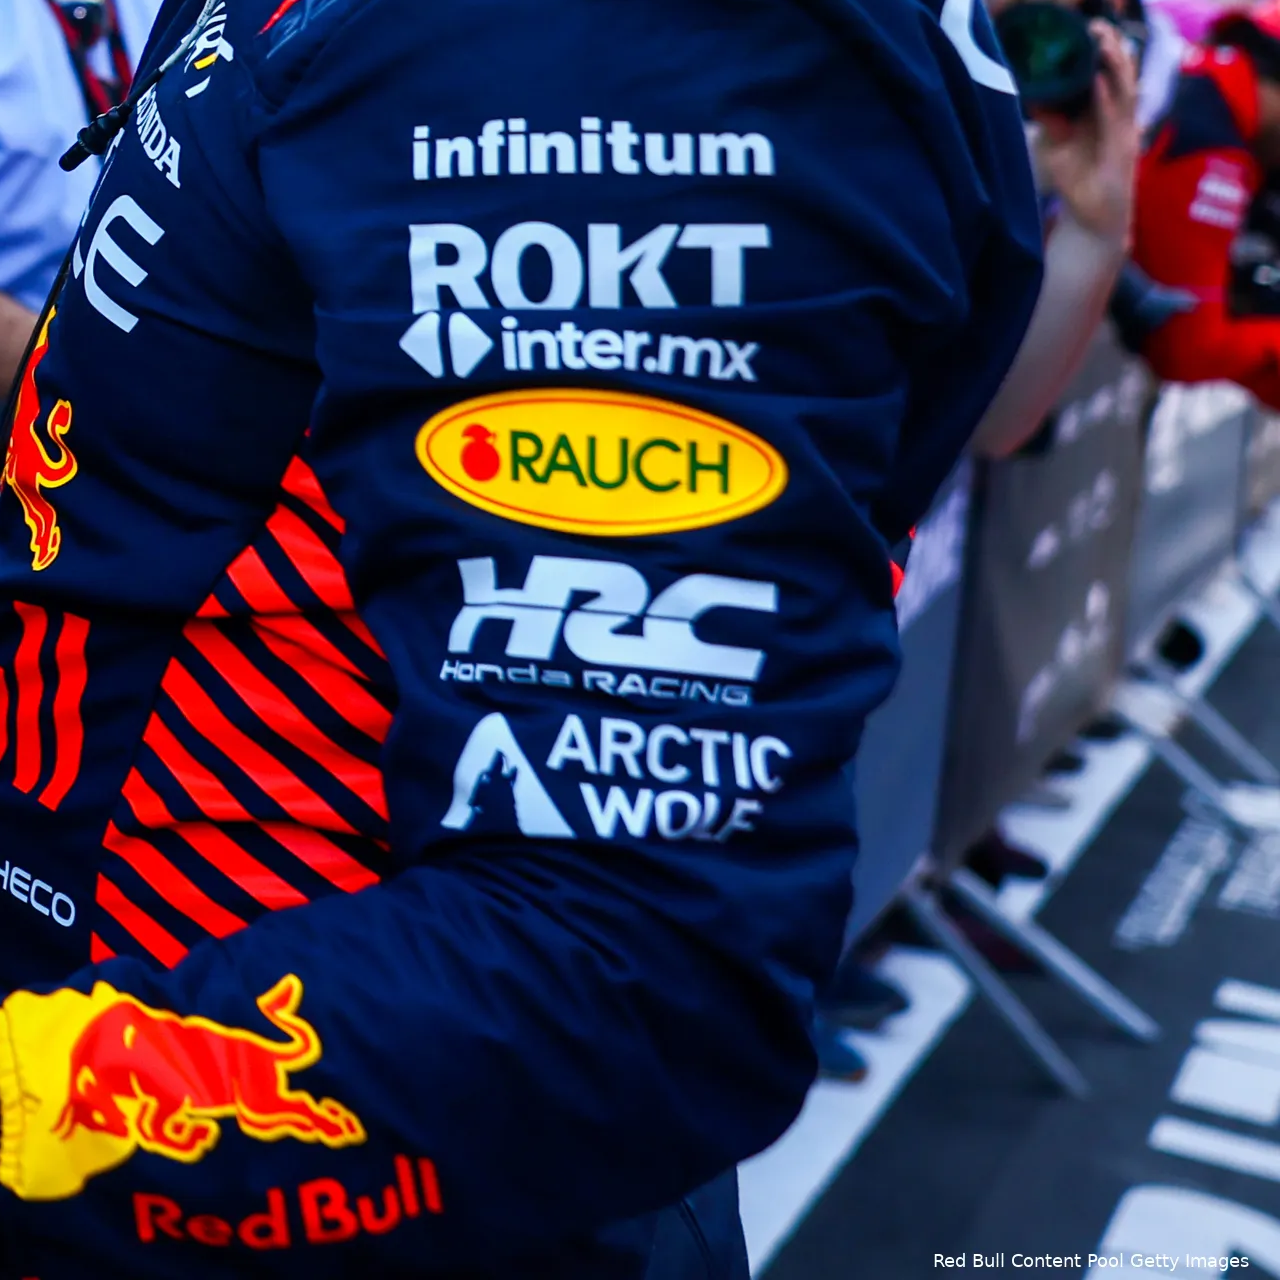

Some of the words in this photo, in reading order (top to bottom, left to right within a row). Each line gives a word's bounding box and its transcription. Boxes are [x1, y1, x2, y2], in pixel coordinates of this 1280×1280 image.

[412, 116, 775, 180] infinitum
[408, 221, 771, 314] ROKT
[501, 317, 758, 382] inter.mx
[510, 431, 730, 494] RAUCH
[447, 554, 778, 681] HRC
[439, 659, 572, 687] Honda
[582, 669, 754, 706] RACING
[546, 714, 792, 794] ARCTIC
[579, 783, 763, 843] WOLF
[133, 1187, 292, 1249] Red
[298, 1154, 442, 1243] Bull
